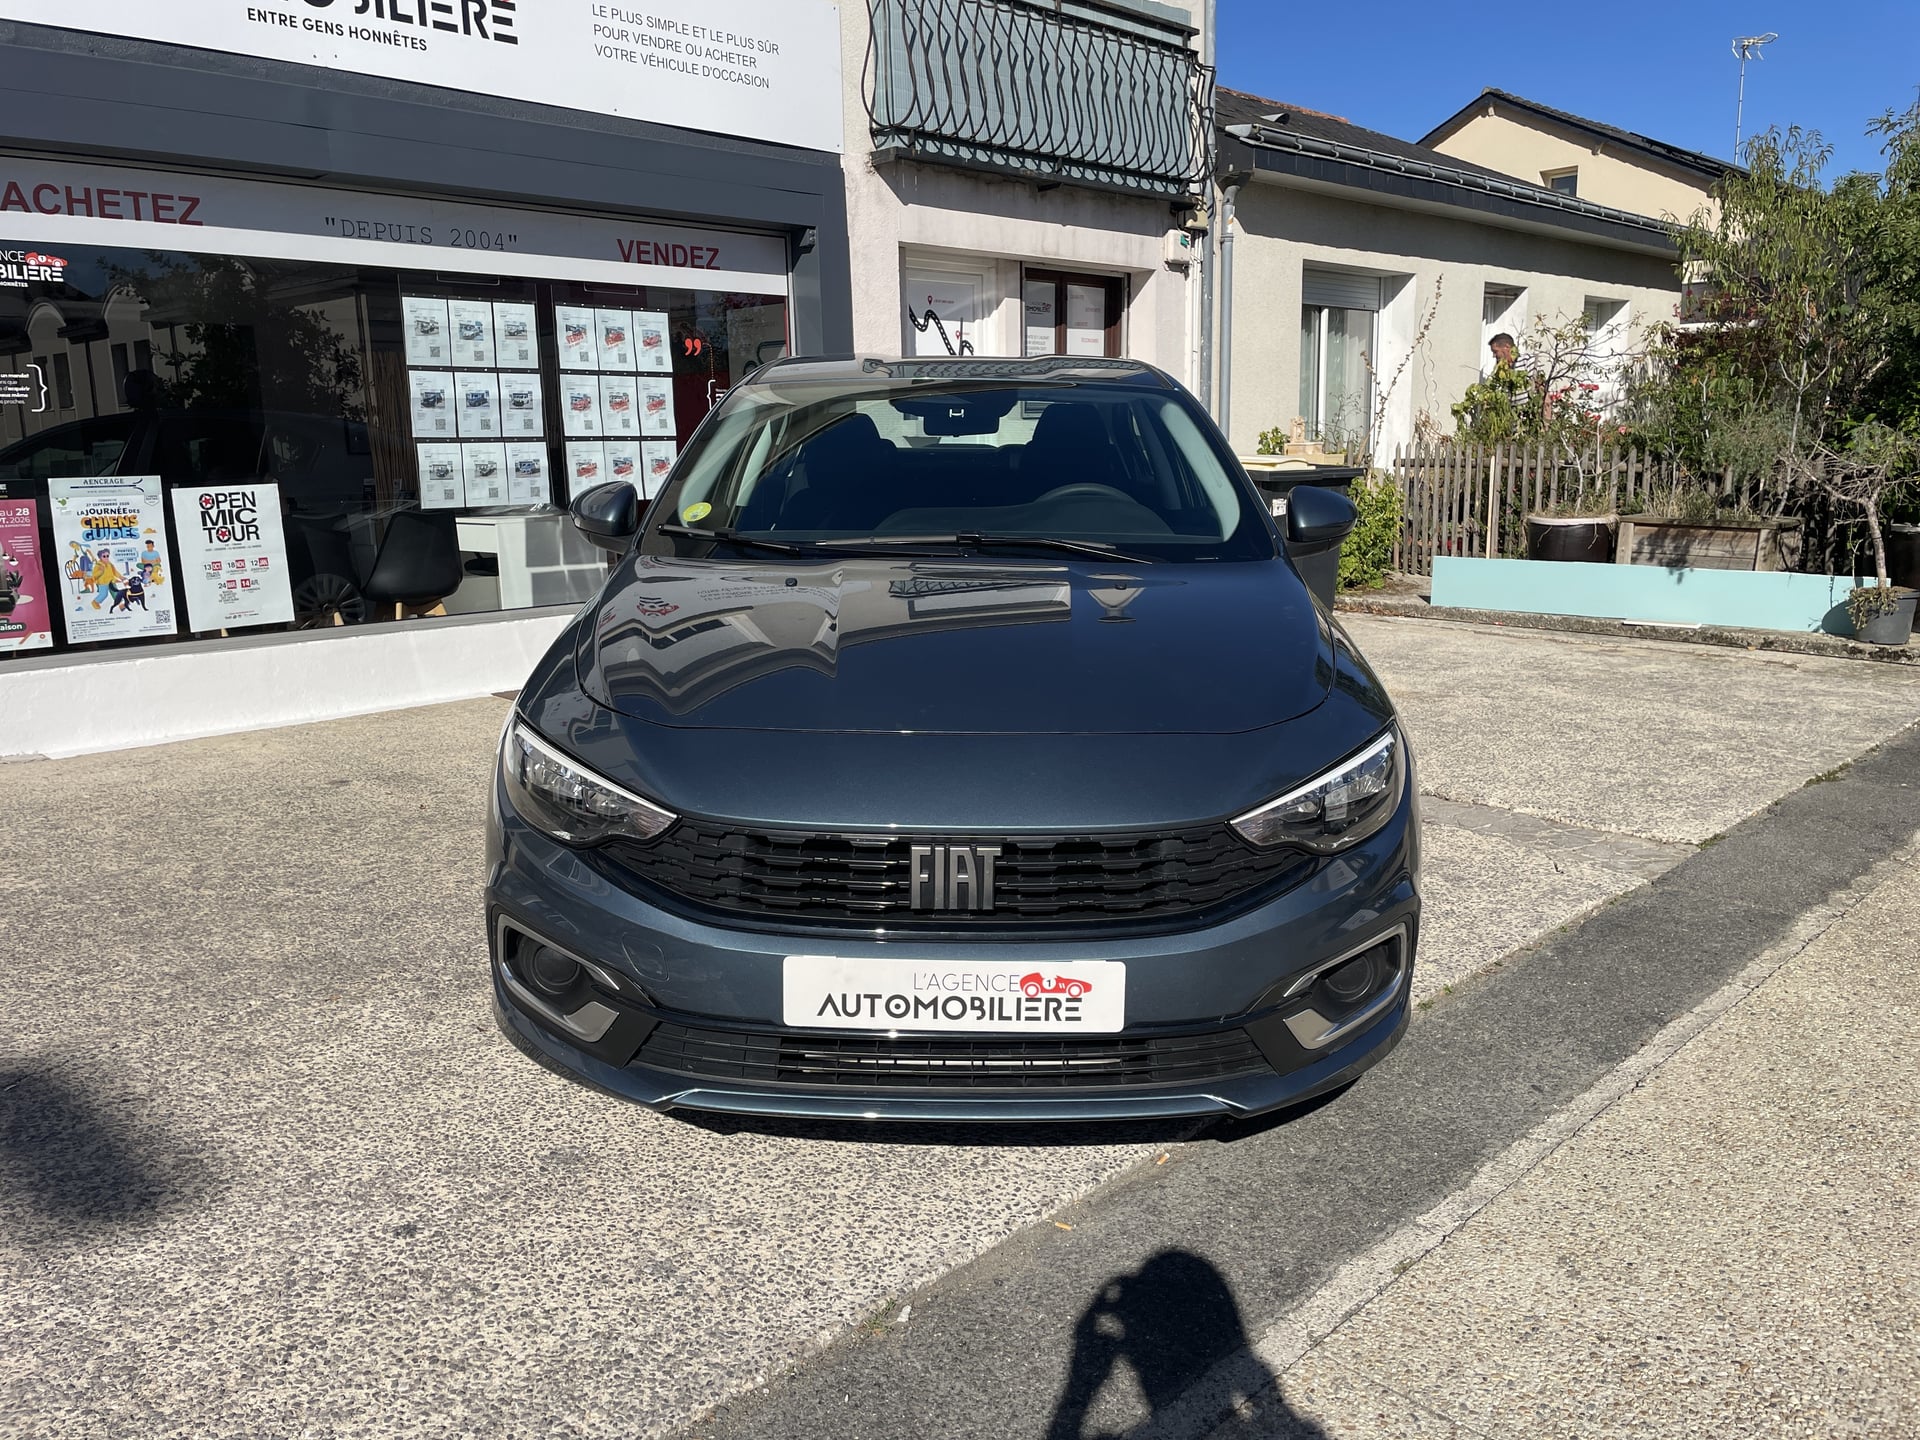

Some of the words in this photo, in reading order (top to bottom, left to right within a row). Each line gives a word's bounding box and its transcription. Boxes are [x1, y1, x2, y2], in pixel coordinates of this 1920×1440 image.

[247, 7, 298, 29] ENTRE
[302, 18, 344, 37] GENS
[349, 25, 428, 51] HONNÊTES
[592, 3, 608, 18] LE
[611, 7, 643, 26] PLUS
[646, 16, 689, 36] SIMPLE
[692, 25, 707, 39] ET
[709, 29, 724, 43] LE
[726, 33, 755, 50] PLUS
[757, 40, 780, 56] SÛR
[593, 24, 629, 43] POUR
[632, 31, 682, 53] VENDRE
[685, 43, 702, 57] OU
[705, 47, 757, 68] ACHETER
[594, 43, 637, 63] VOTRE
[640, 52, 699, 75] VÉHICULE
[702, 65, 770, 89] D'OCCASION
[0, 180, 204, 226] ACHETEZ
[616, 238, 721, 270] VENDEZ
[199, 491, 257, 510] OPEN
[0, 509, 13, 517] au
[15, 507, 30, 516] 28
[10, 516, 31, 524] 2026
[85, 506, 128, 516] JOURNÉE
[200, 508, 258, 527] MIC
[80, 514, 139, 529] CHIENS
[82, 527, 141, 542] GUIDES
[202, 524, 260, 544] TOUR
[241, 580, 250, 588] 14
[910, 843, 1002, 911] FIAT
[912, 972, 1020, 993] L'AGENCE
[816, 993, 1082, 1022] AUTOMOBILIERE
